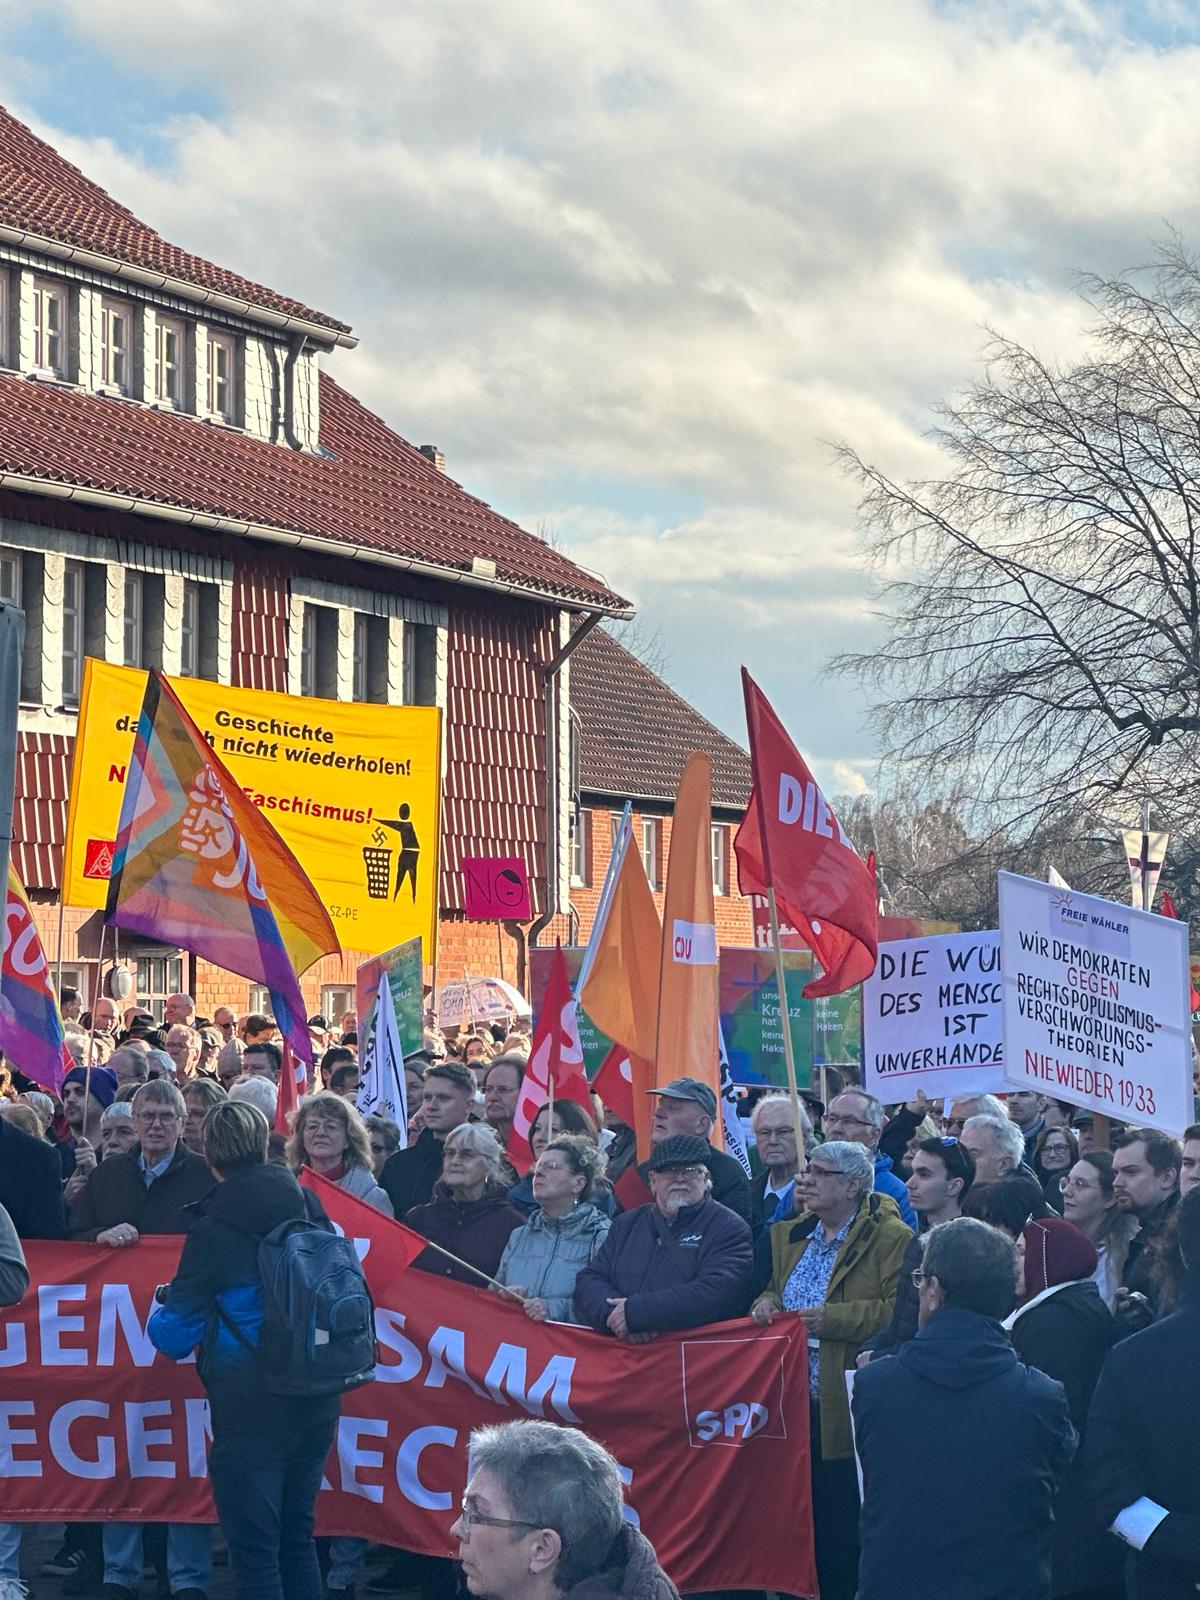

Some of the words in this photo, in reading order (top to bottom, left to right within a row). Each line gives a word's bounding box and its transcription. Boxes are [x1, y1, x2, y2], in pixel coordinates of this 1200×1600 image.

[215, 710, 334, 744] Geschichte
[116, 716, 139, 733] da
[223, 737, 278, 758] nicht
[285, 747, 411, 776] wiederholen!
[778, 772, 834, 840] DIE
[468, 869, 524, 906] NO
[1061, 908, 1088, 922] FREIE
[1091, 915, 1129, 934] WÄHLER
[674, 937, 692, 960] CDU
[880, 950, 930, 980] DIE
[1053, 940, 1150, 988] DEMOKRATEN
[880, 993, 922, 1017] DES
[939, 982, 1002, 1008] MENSC
[1067, 967, 1119, 1000] GEGEN
[1017, 973, 1162, 1033] RECHTSPOPULISMUS-
[762, 1018, 777, 1026] hat
[944, 1013, 988, 1036] IST
[1018, 997, 1153, 1053] VERSCHWÖRUNGS-
[762, 1043, 785, 1054] Hake
[876, 1043, 1003, 1073] UNVERHANDE
[1048, 1029, 1124, 1067] THEORIEN
[1118, 1079, 1156, 1115] 1933
[695, 1402, 769, 1441] SPD
